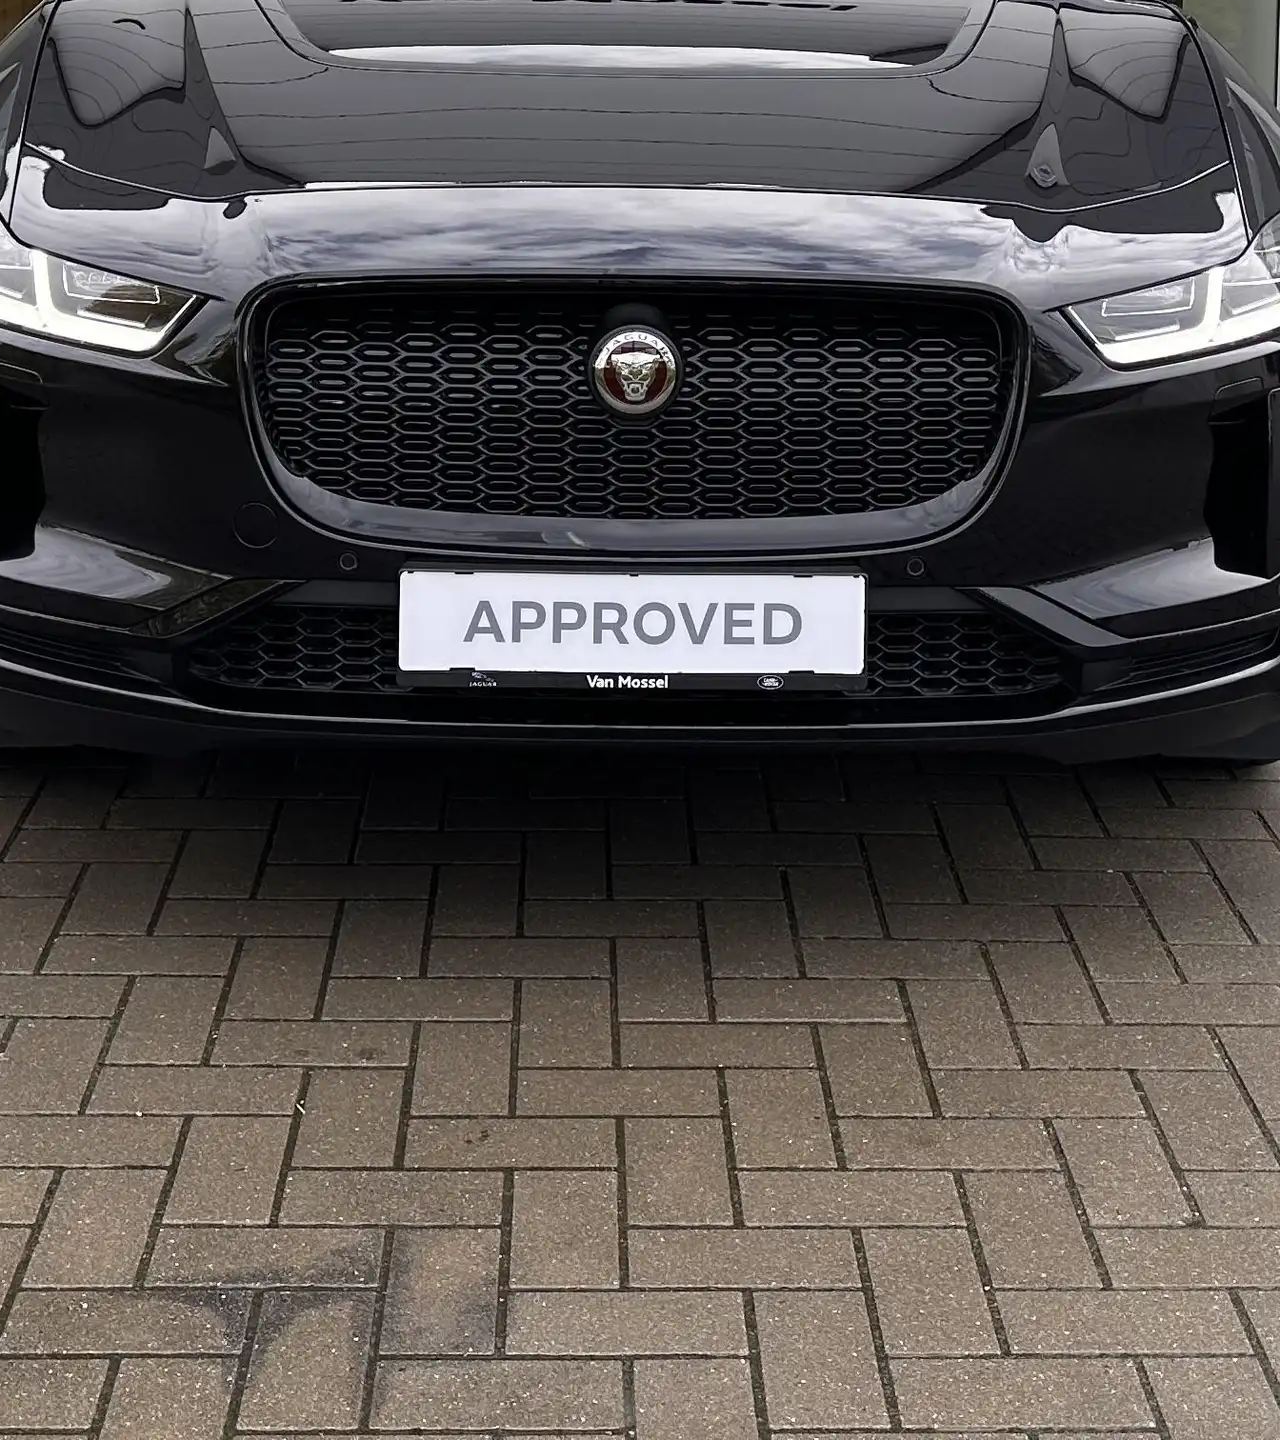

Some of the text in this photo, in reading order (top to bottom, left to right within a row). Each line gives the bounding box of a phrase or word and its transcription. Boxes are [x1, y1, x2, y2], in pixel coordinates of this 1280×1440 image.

[605, 333, 670, 358] JAGUAR
[463, 600, 803, 645] APPROVED
[586, 674, 669, 689] Van Mossel
